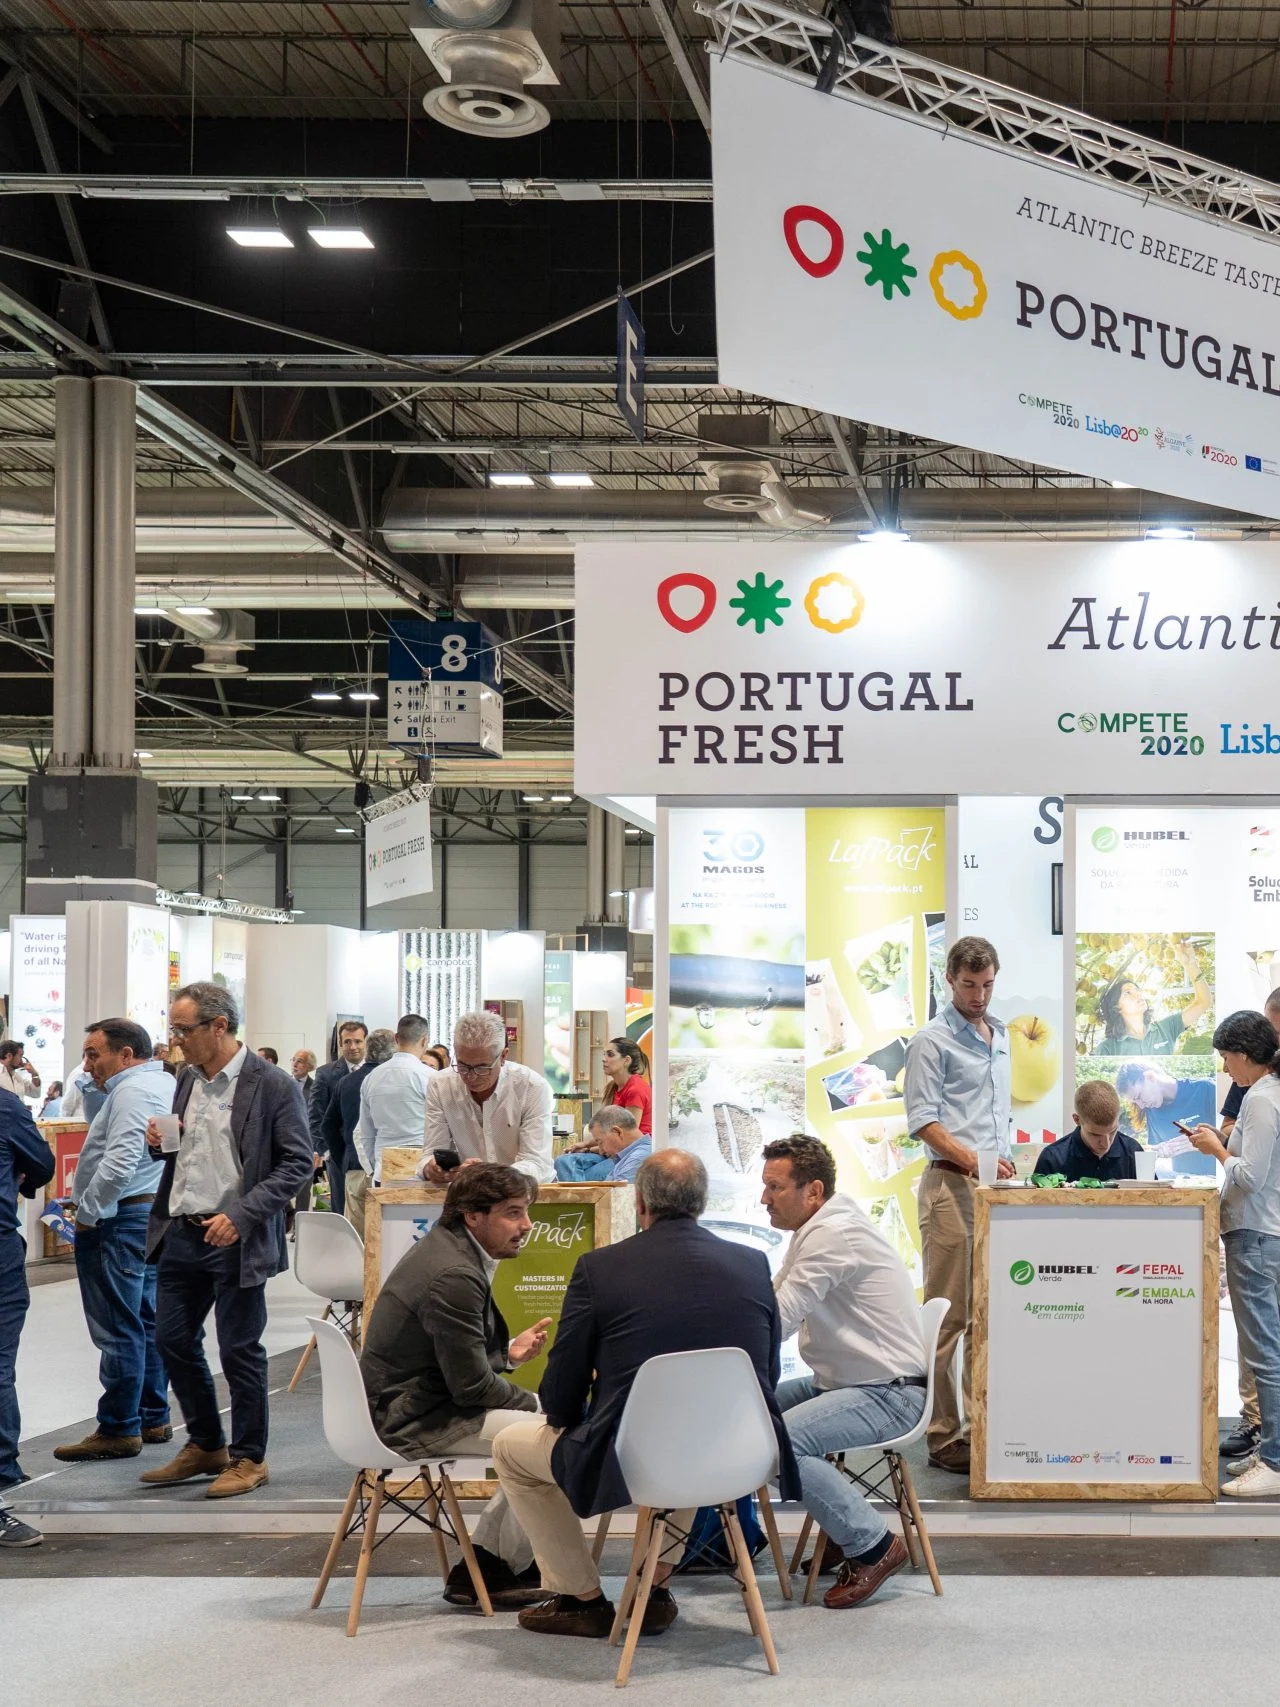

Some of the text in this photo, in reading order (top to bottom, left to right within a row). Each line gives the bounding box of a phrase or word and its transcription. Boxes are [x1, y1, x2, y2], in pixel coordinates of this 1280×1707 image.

[1017, 197, 1134, 250] ATLANTIC
[1141, 235, 1220, 276] BREEZE
[1054, 414, 1080, 429] 2020
[1210, 451, 1238, 466] 2020
[441, 634, 468, 672] 8
[494, 648, 501, 685] 8
[658, 671, 974, 712] PORTUGAL
[407, 715, 457, 723] Salida Exit
[658, 724, 845, 765] FRESH
[1140, 735, 1205, 756] 2020
[1124, 831, 1190, 841] HUBEL
[24, 945, 60, 955] driving
[24, 957, 34, 965] of
[37, 957, 49, 965] all
[427, 959, 472, 967] campotec
[519, 1212, 586, 1248] fPack
[1038, 1265, 1097, 1274] HUBEL
[1143, 1265, 1184, 1275] FEPAL
[1142, 1288, 1196, 1298] EMBALA
[1024, 1302, 1085, 1314] Agronomia
[1037, 1312, 1085, 1323] em campo
